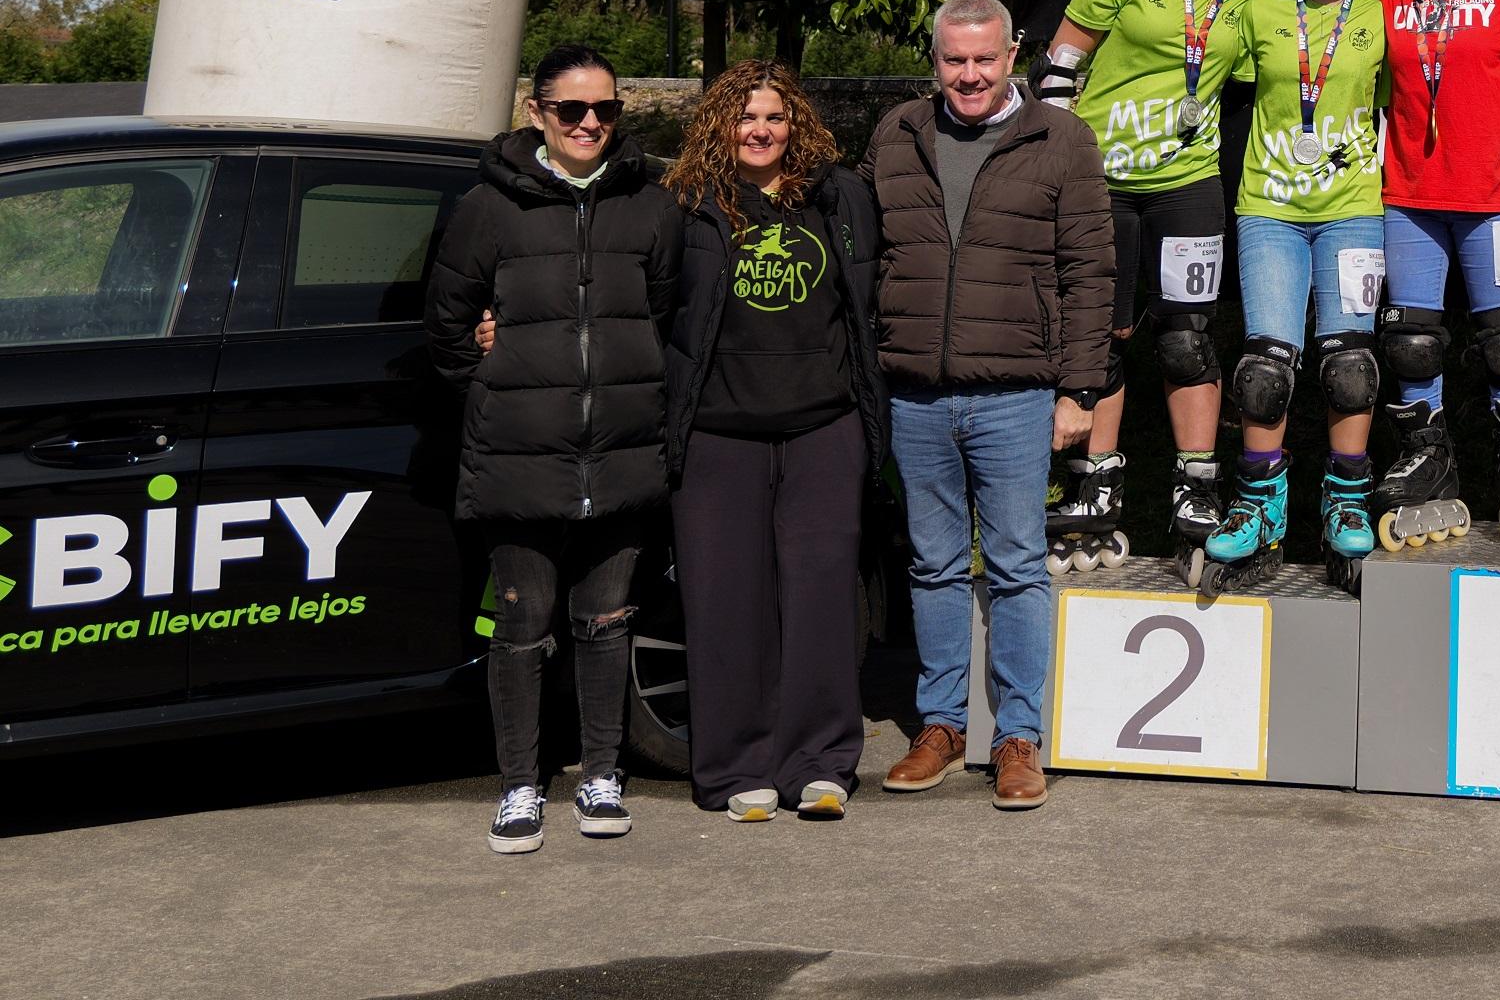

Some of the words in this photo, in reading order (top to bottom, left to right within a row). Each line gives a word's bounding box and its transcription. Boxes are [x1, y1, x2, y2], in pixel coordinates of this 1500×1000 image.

[1185, 262, 1216, 296] 87
[0, 628, 43, 652] ca
[51, 619, 140, 652] para
[148, 602, 281, 636] llevarte
[289, 592, 367, 624] lejos
[1116, 615, 1206, 753] 2
